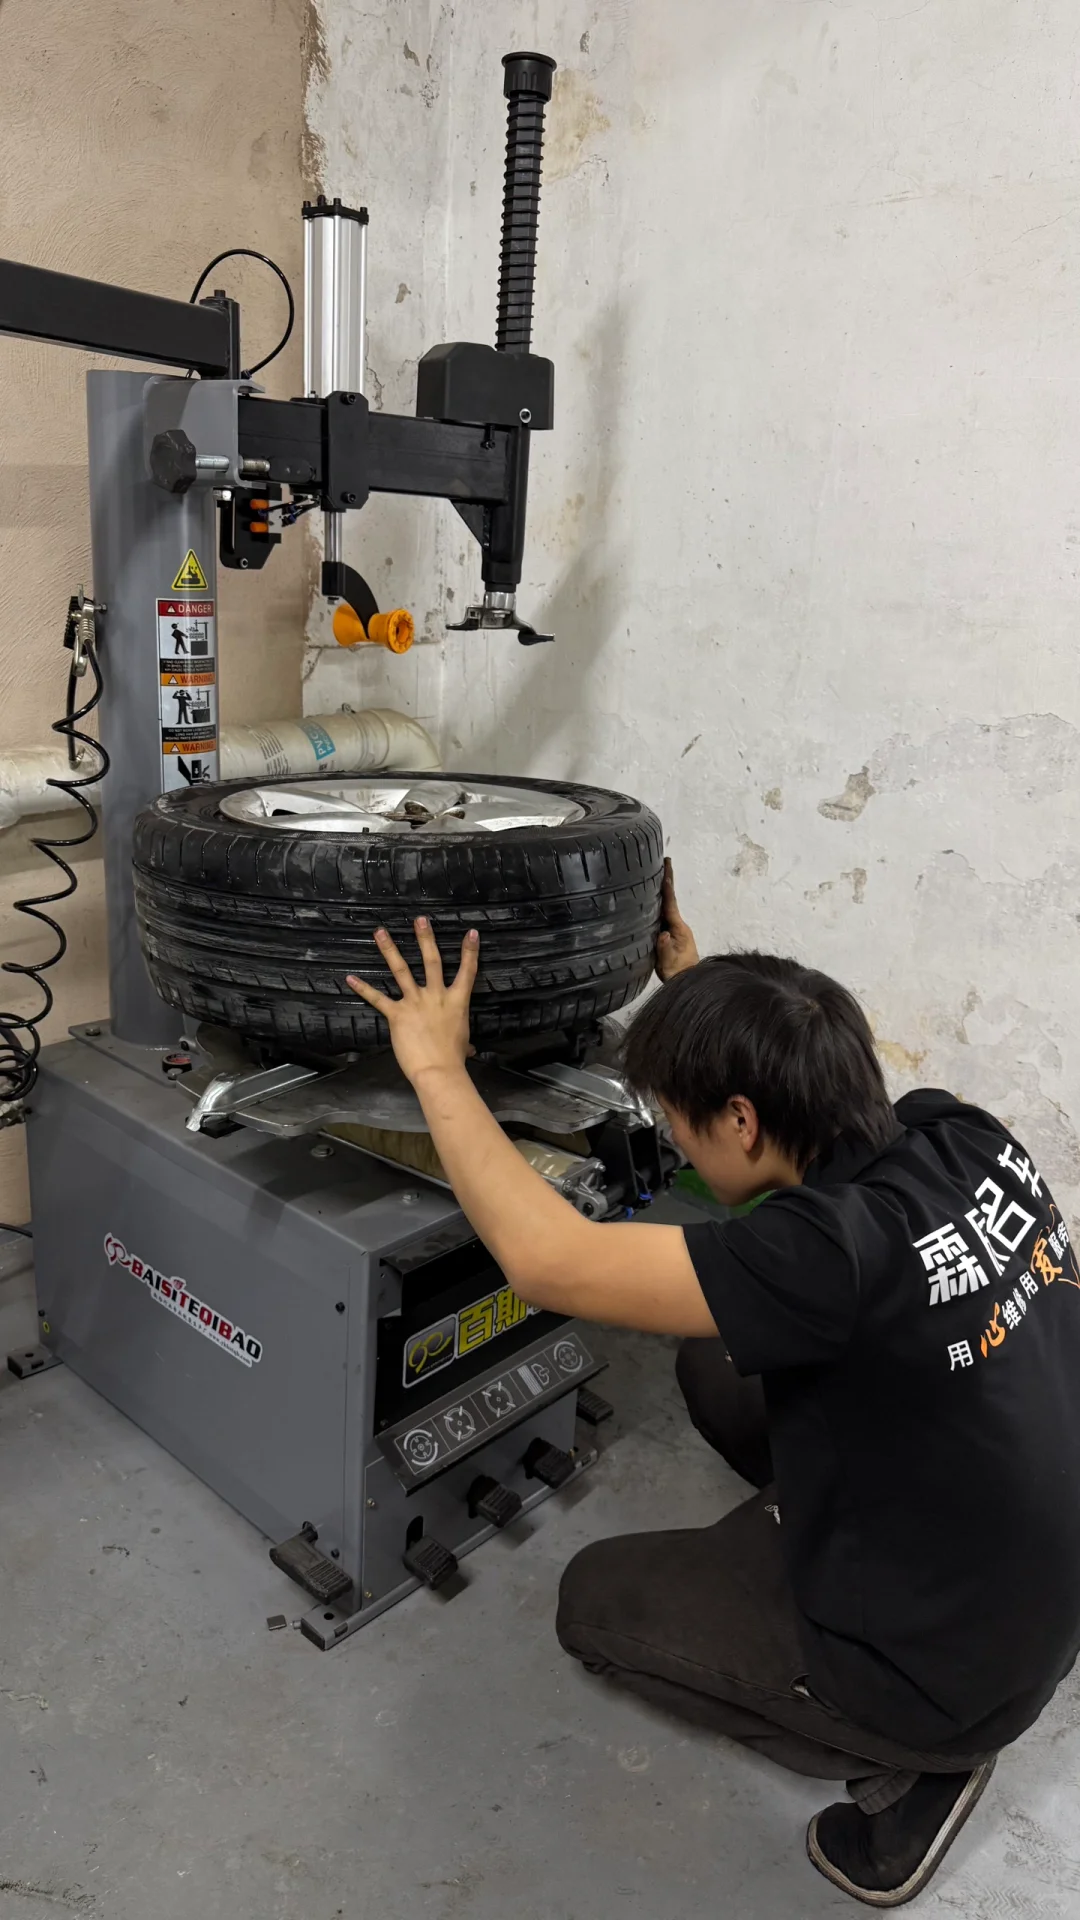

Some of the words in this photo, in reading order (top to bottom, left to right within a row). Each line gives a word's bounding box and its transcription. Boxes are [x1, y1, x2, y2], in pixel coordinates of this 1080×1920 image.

[178, 604, 212, 614] DANGER
[180, 673, 214, 684] WARNING
[182, 741, 214, 752] WARNING
[131, 1257, 261, 1360] BAISITEQIBAO
[458, 1287, 543, 1355] 百斯
